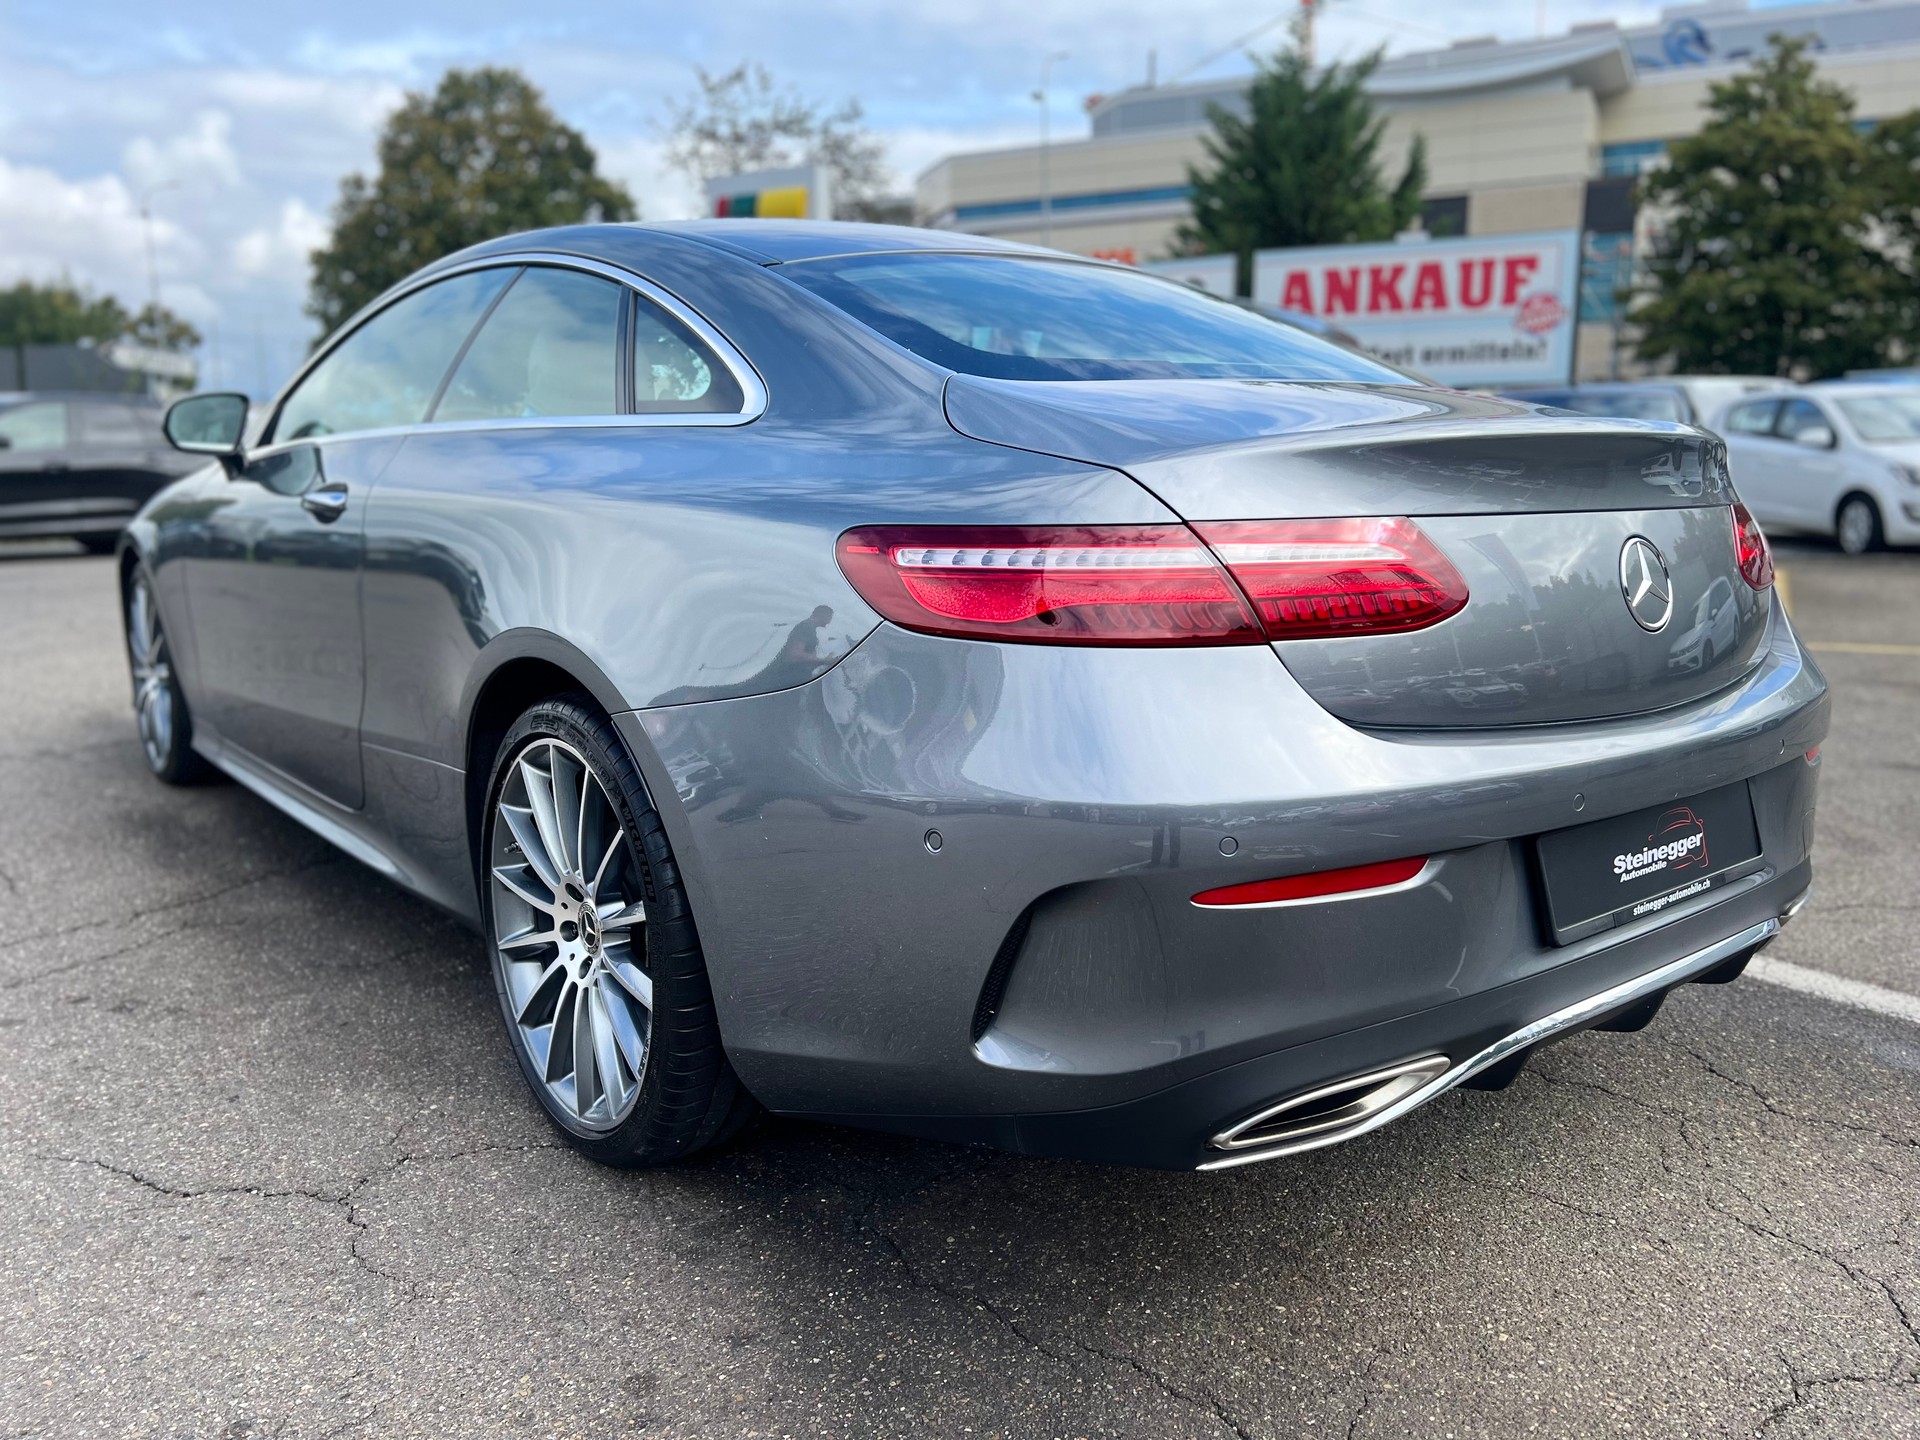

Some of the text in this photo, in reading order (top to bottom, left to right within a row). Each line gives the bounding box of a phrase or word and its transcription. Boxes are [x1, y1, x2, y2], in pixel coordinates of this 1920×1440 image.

[1282, 255, 1538, 316] ANKAUF
[622, 806, 655, 898] MICHELIN
[1613, 832, 1703, 874] Steinegger
[1620, 860, 1667, 883] Automobile
[1633, 880, 1711, 916] steinegger-automobile.ch
